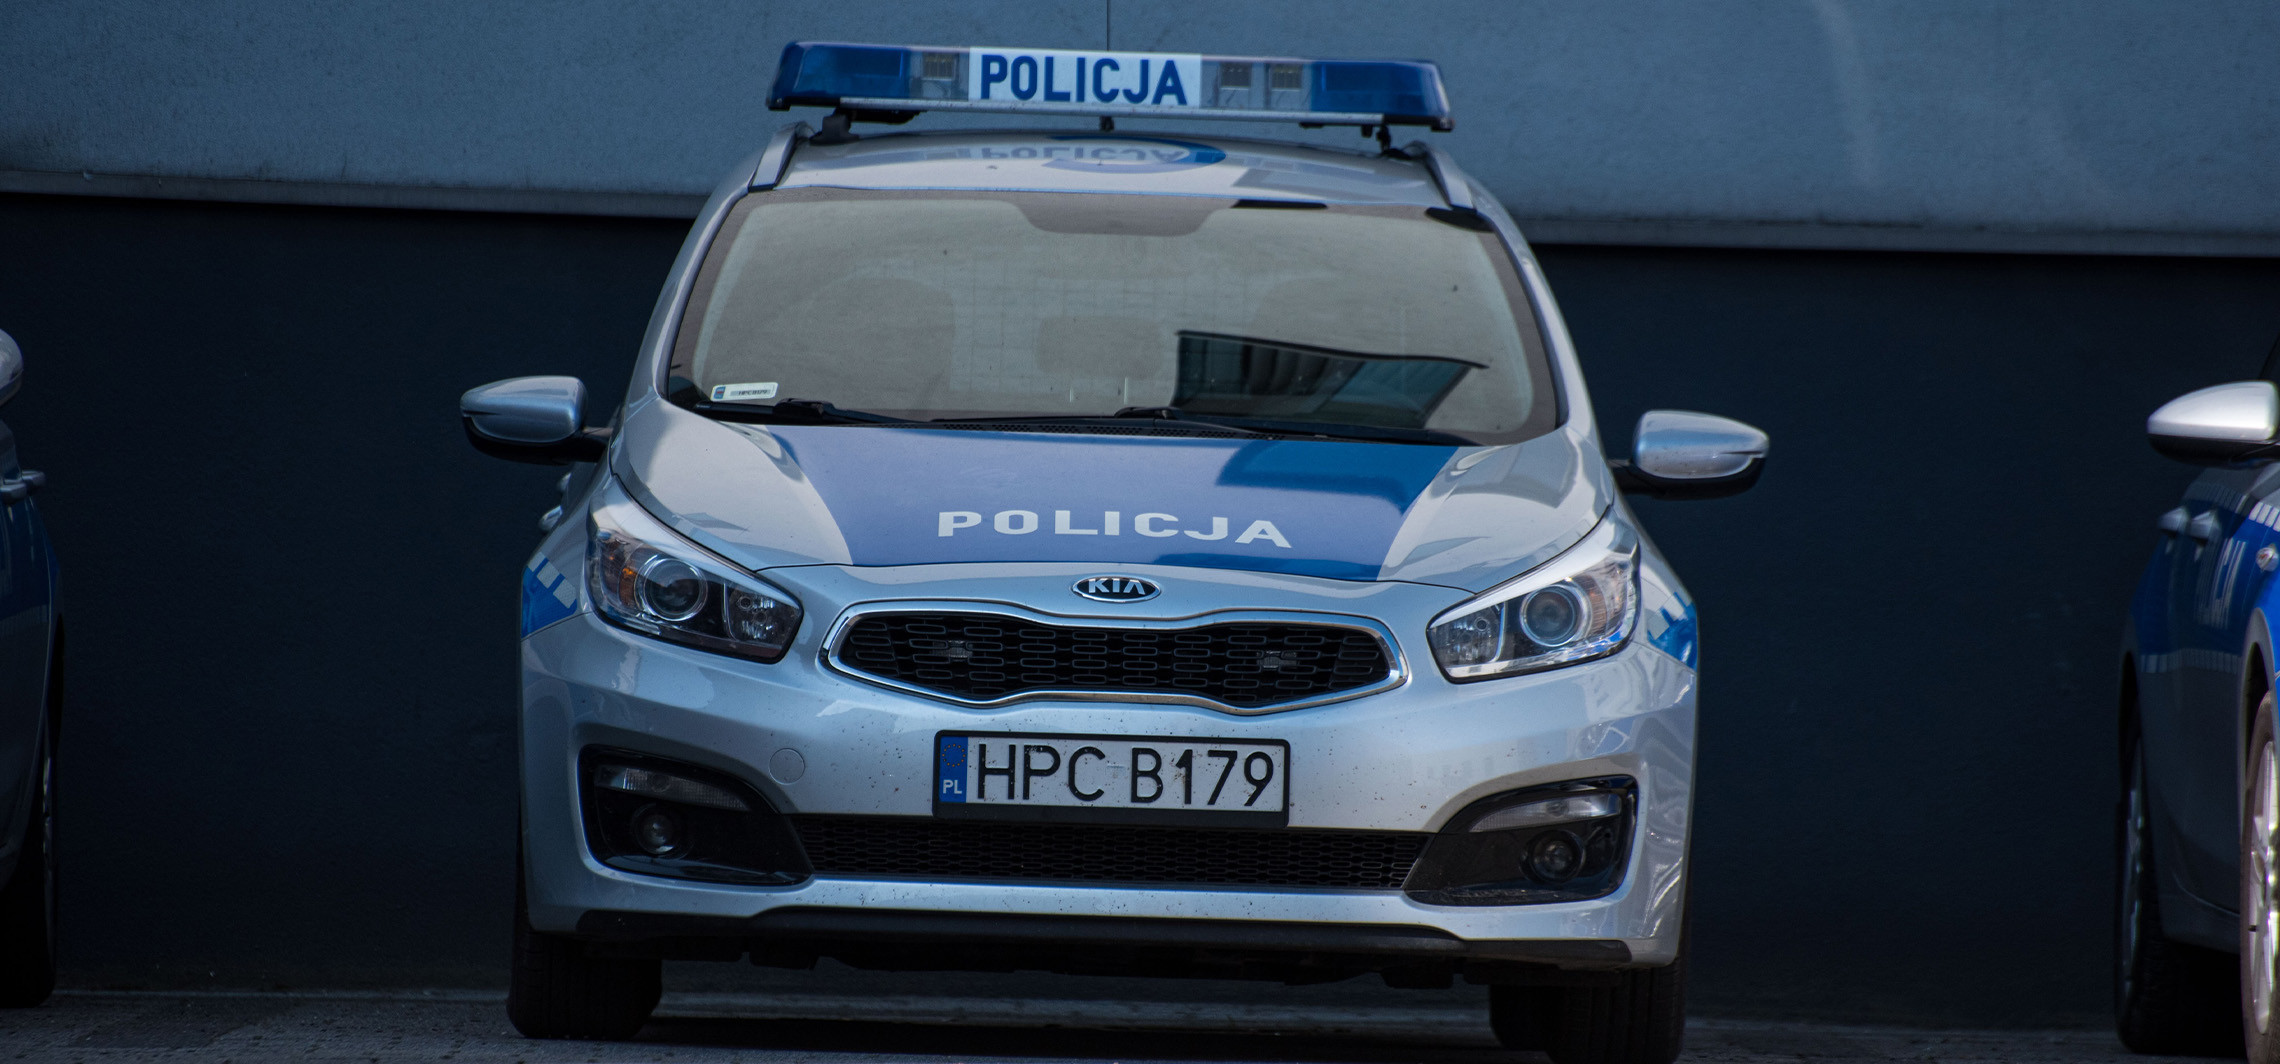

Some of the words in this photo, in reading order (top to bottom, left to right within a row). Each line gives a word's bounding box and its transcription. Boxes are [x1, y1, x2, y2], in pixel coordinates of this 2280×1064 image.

[980, 54, 1188, 105] POLICJA
[937, 509, 1292, 549] POLICJA
[1088, 577, 1146, 596] KIA
[942, 779, 963, 795] PL
[976, 743, 1107, 802] HPC
[1130, 746, 1275, 807] B179
